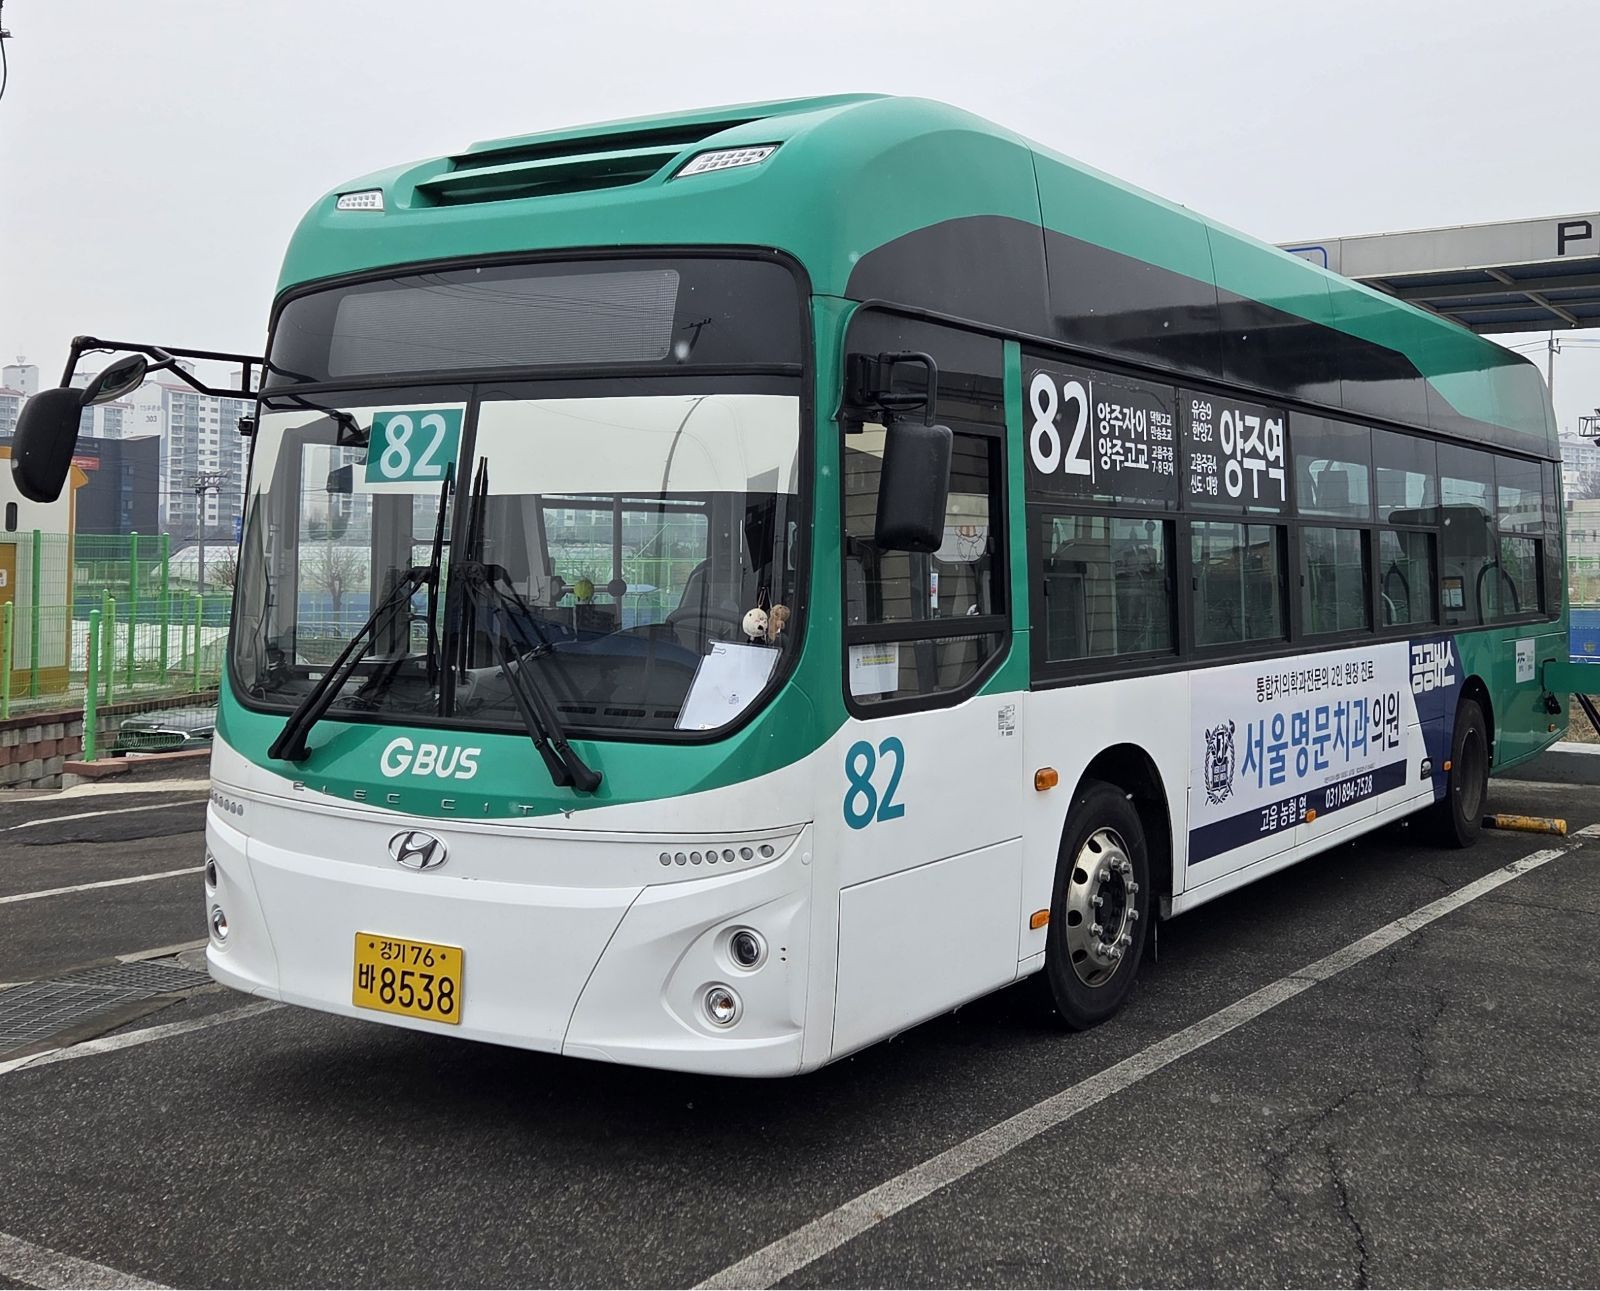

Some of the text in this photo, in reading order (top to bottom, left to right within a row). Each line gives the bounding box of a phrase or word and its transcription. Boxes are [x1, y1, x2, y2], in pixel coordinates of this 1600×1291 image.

[1557, 220, 1593, 256] P
[1029, 373, 1091, 476] 82
[1097, 402, 1147, 441] 양주자이
[1191, 400, 1212, 420] 유승9
[380, 413, 446, 478] 82
[1192, 421, 1213, 442] 한양2
[1098, 437, 1149, 471] 양주고교
[1151, 446, 1173, 461] 고읍주공
[1190, 453, 1217, 474] 고읍주공4
[1219, 409, 1286, 502] 양주역
[1256, 660, 1374, 703] 통합치의학과전문의 2인 원장 진료
[1411, 640, 1455, 695] 공공버스
[1241, 691, 1400, 789] 서울명문치과의원
[843, 736, 905, 830] 82
[1325, 774, 1373, 809] 031)894-7528
[1260, 805, 1279, 832] 고읍
[1280, 798, 1297, 826] 농협
[380, 941, 435, 968] 경기 76
